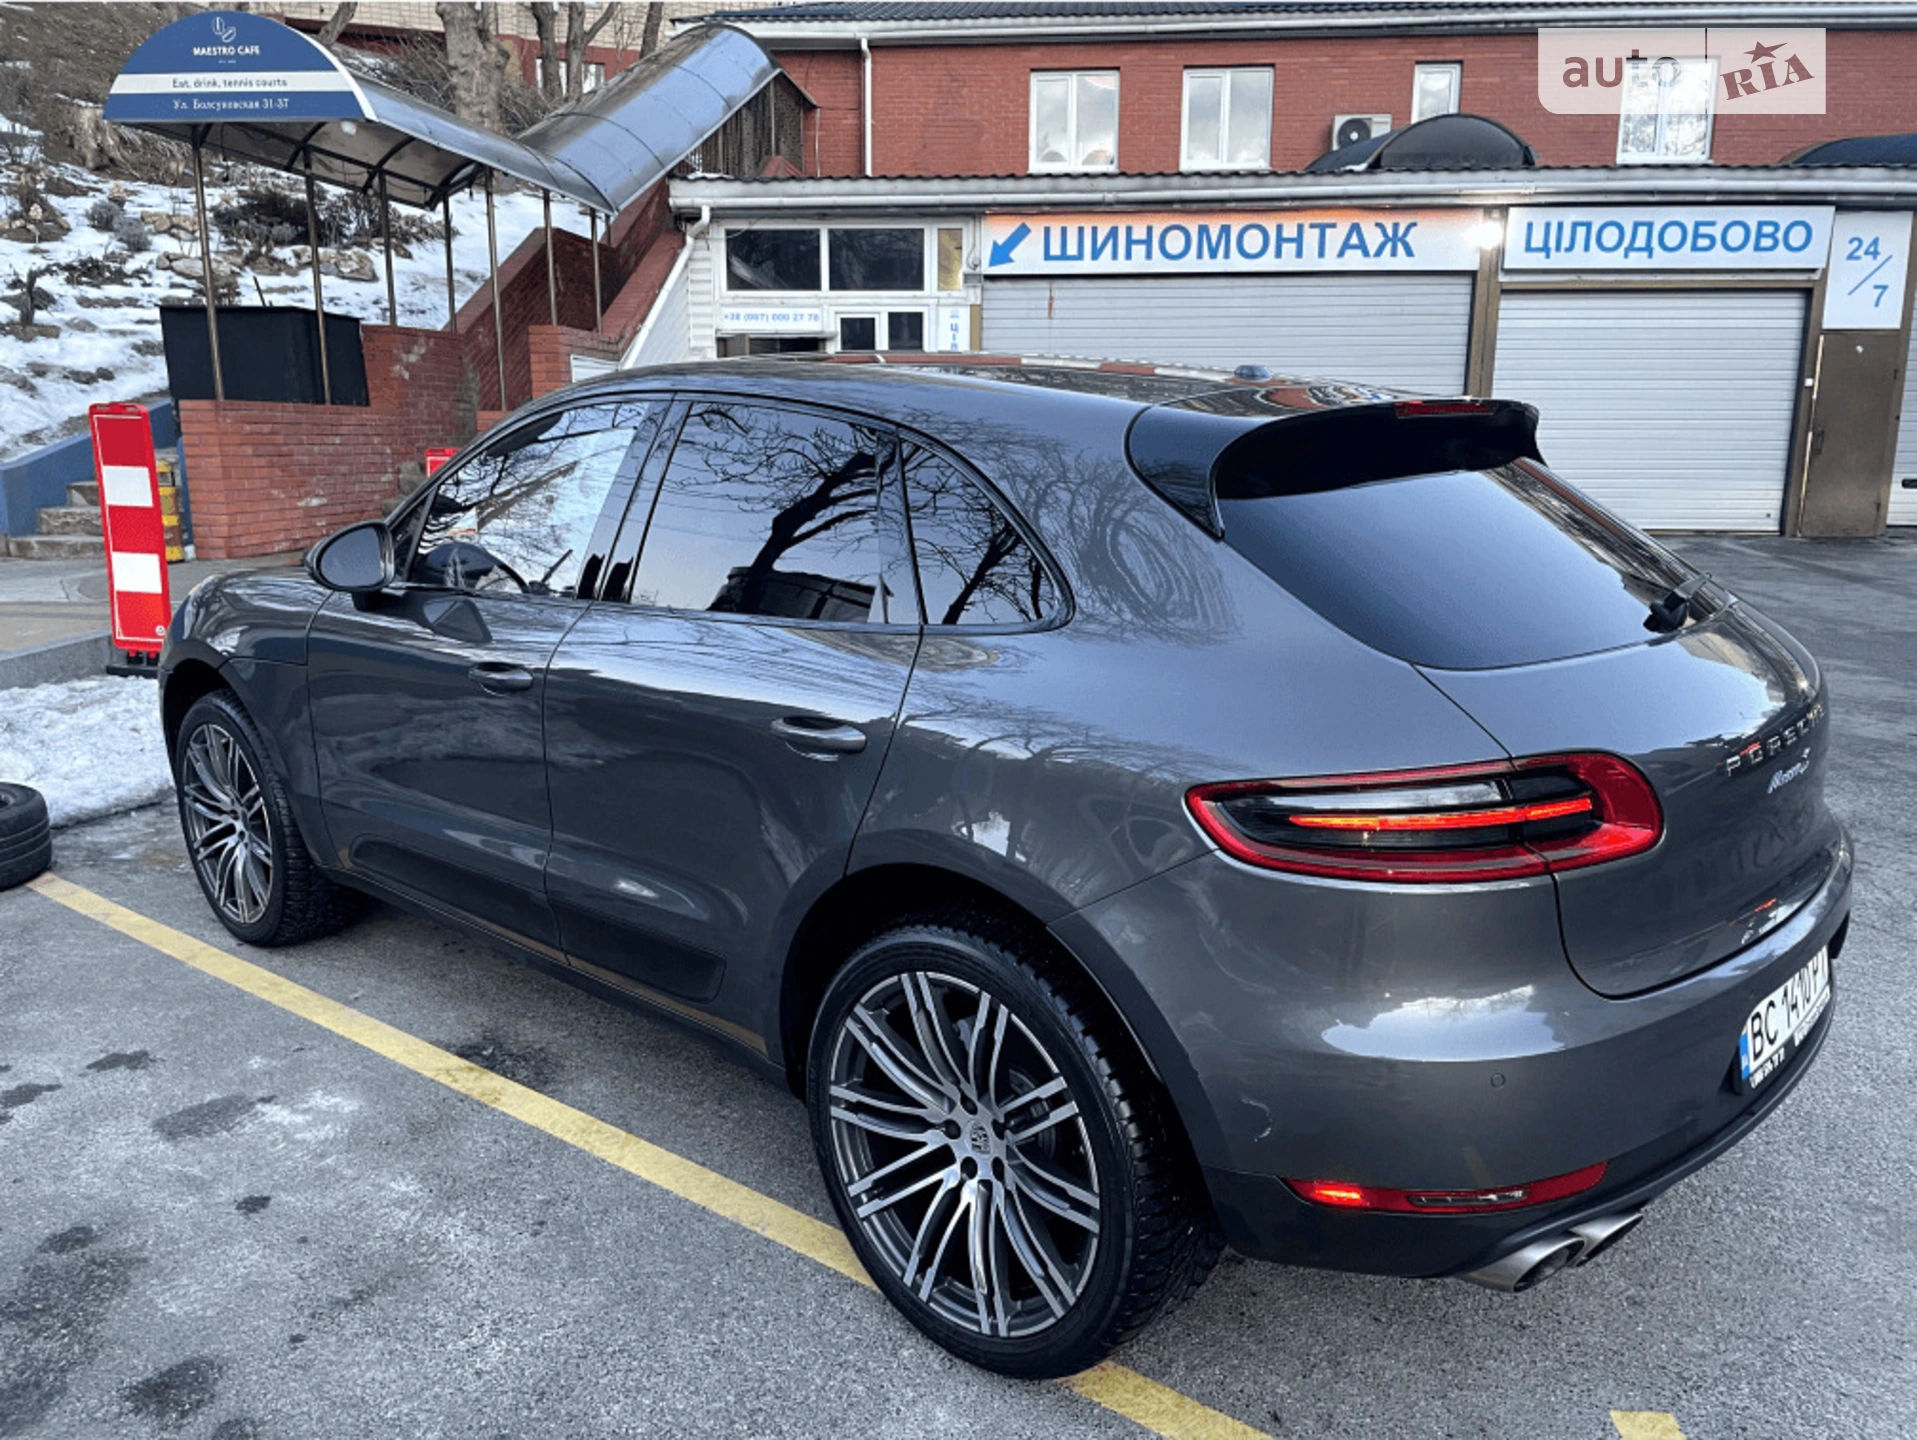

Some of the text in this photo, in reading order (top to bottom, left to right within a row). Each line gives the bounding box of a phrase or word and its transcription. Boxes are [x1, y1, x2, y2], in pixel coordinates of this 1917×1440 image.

[192, 45, 260, 56] MAESTRO CAFE
[223, 79, 254, 88] tennis
[255, 79, 288, 88] courts
[1043, 221, 1418, 262] ШИНОМОНТАЖ
[1524, 219, 1814, 260] ЦІЛОДОБОВО
[1750, 999, 1778, 1061] BC
